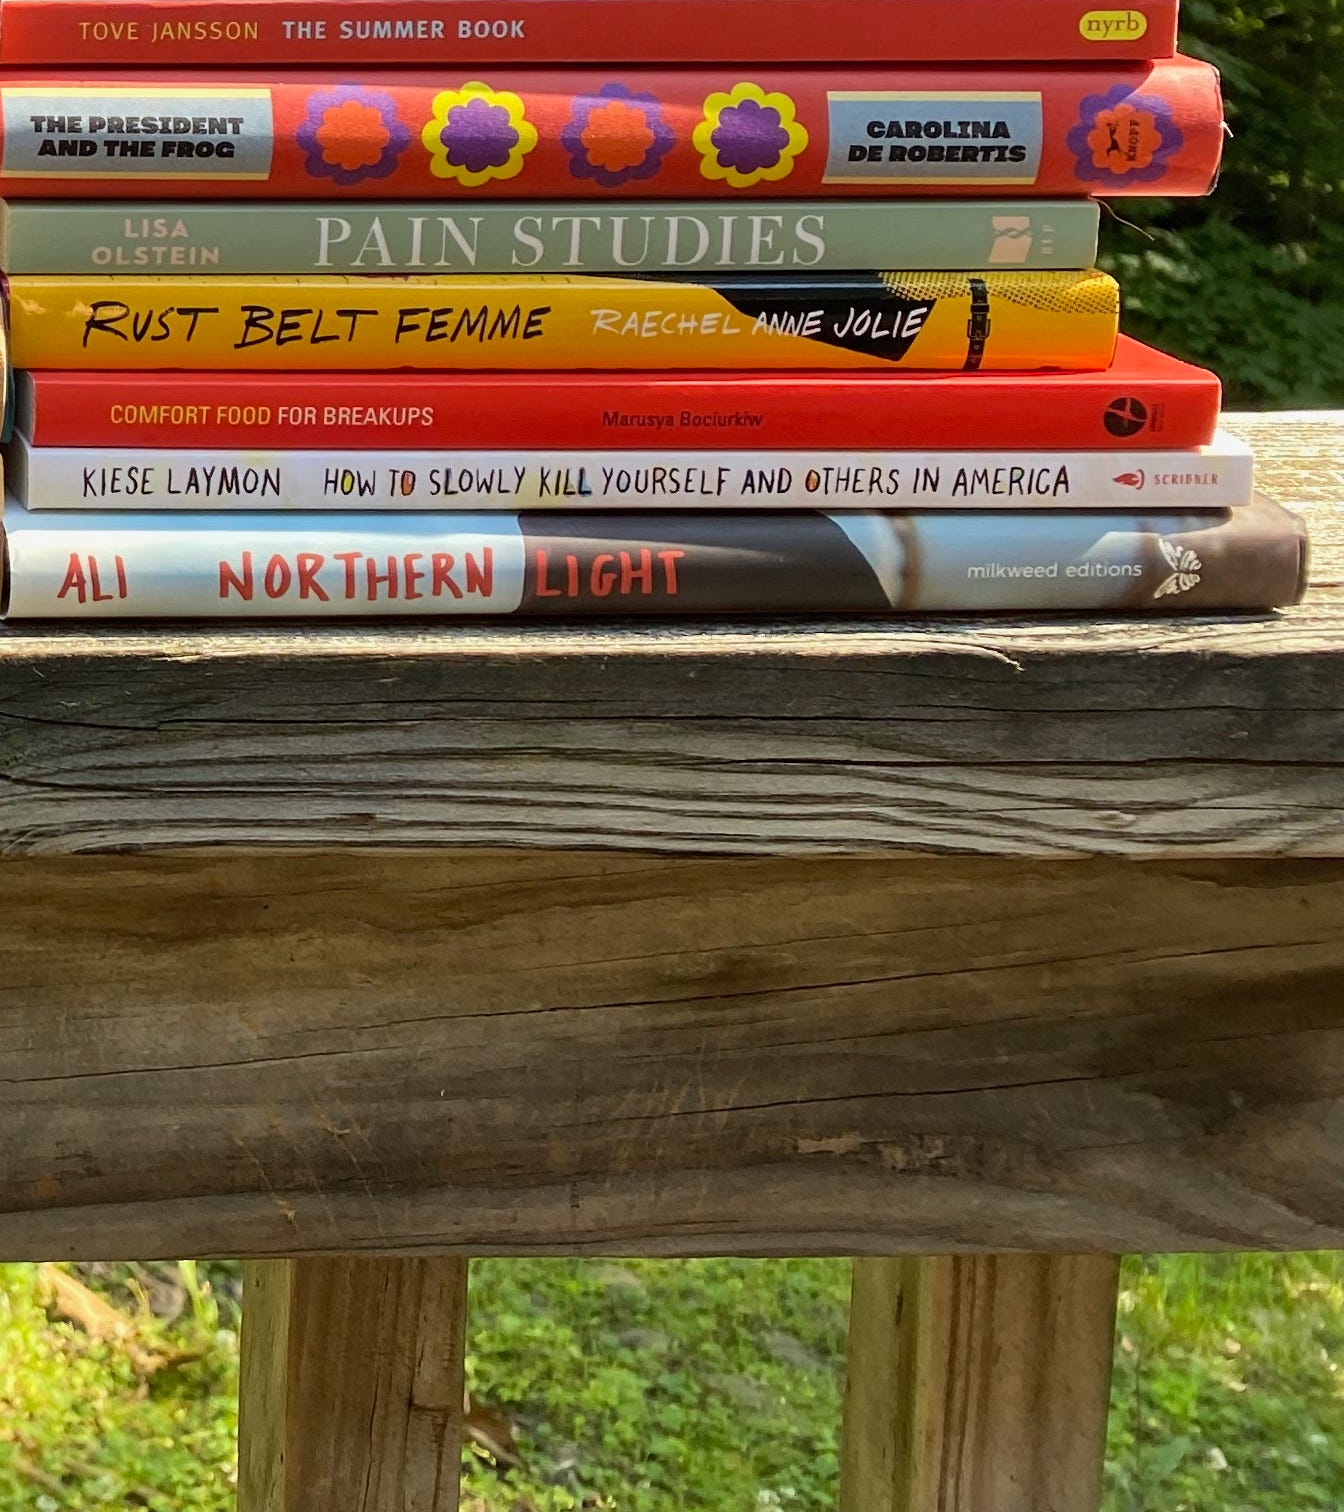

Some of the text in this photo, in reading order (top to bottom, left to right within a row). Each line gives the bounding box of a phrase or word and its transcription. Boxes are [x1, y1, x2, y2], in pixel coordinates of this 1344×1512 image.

[79, 21, 260, 42] TOVE JANSSON
[282, 19, 525, 40] THE SUMMER BOOK
[1085, 13, 1141, 36] nyrb
[30, 115, 244, 135] THE PRESIDENT
[866, 120, 1011, 140] CAROLINA
[38, 139, 236, 158] AND THE FROG
[847, 144, 1026, 163] DE ROBERTIS
[123, 218, 189, 239] LISA
[313, 216, 827, 268] PAIN STUDIES
[91, 245, 220, 266] OLSTEIN
[82, 300, 552, 350] RUST BELT FEMME
[590, 306, 929, 339] RAECHEL ANNE JOLIE
[110, 404, 434, 427] COMFORT FOOD FOR BREAKUPS
[602, 410, 764, 430] Marusya Bociurkiw
[82, 466, 281, 498] KIESE LAYMON
[323, 465, 1072, 497] HOW TO SLOWLY KILL YOURSELF AND OTHERS IN AMERICA
[56, 551, 130, 605] ALI
[218, 545, 686, 602] NORTHERN LIGHT
[967, 562, 1143, 580] milkweed editions
